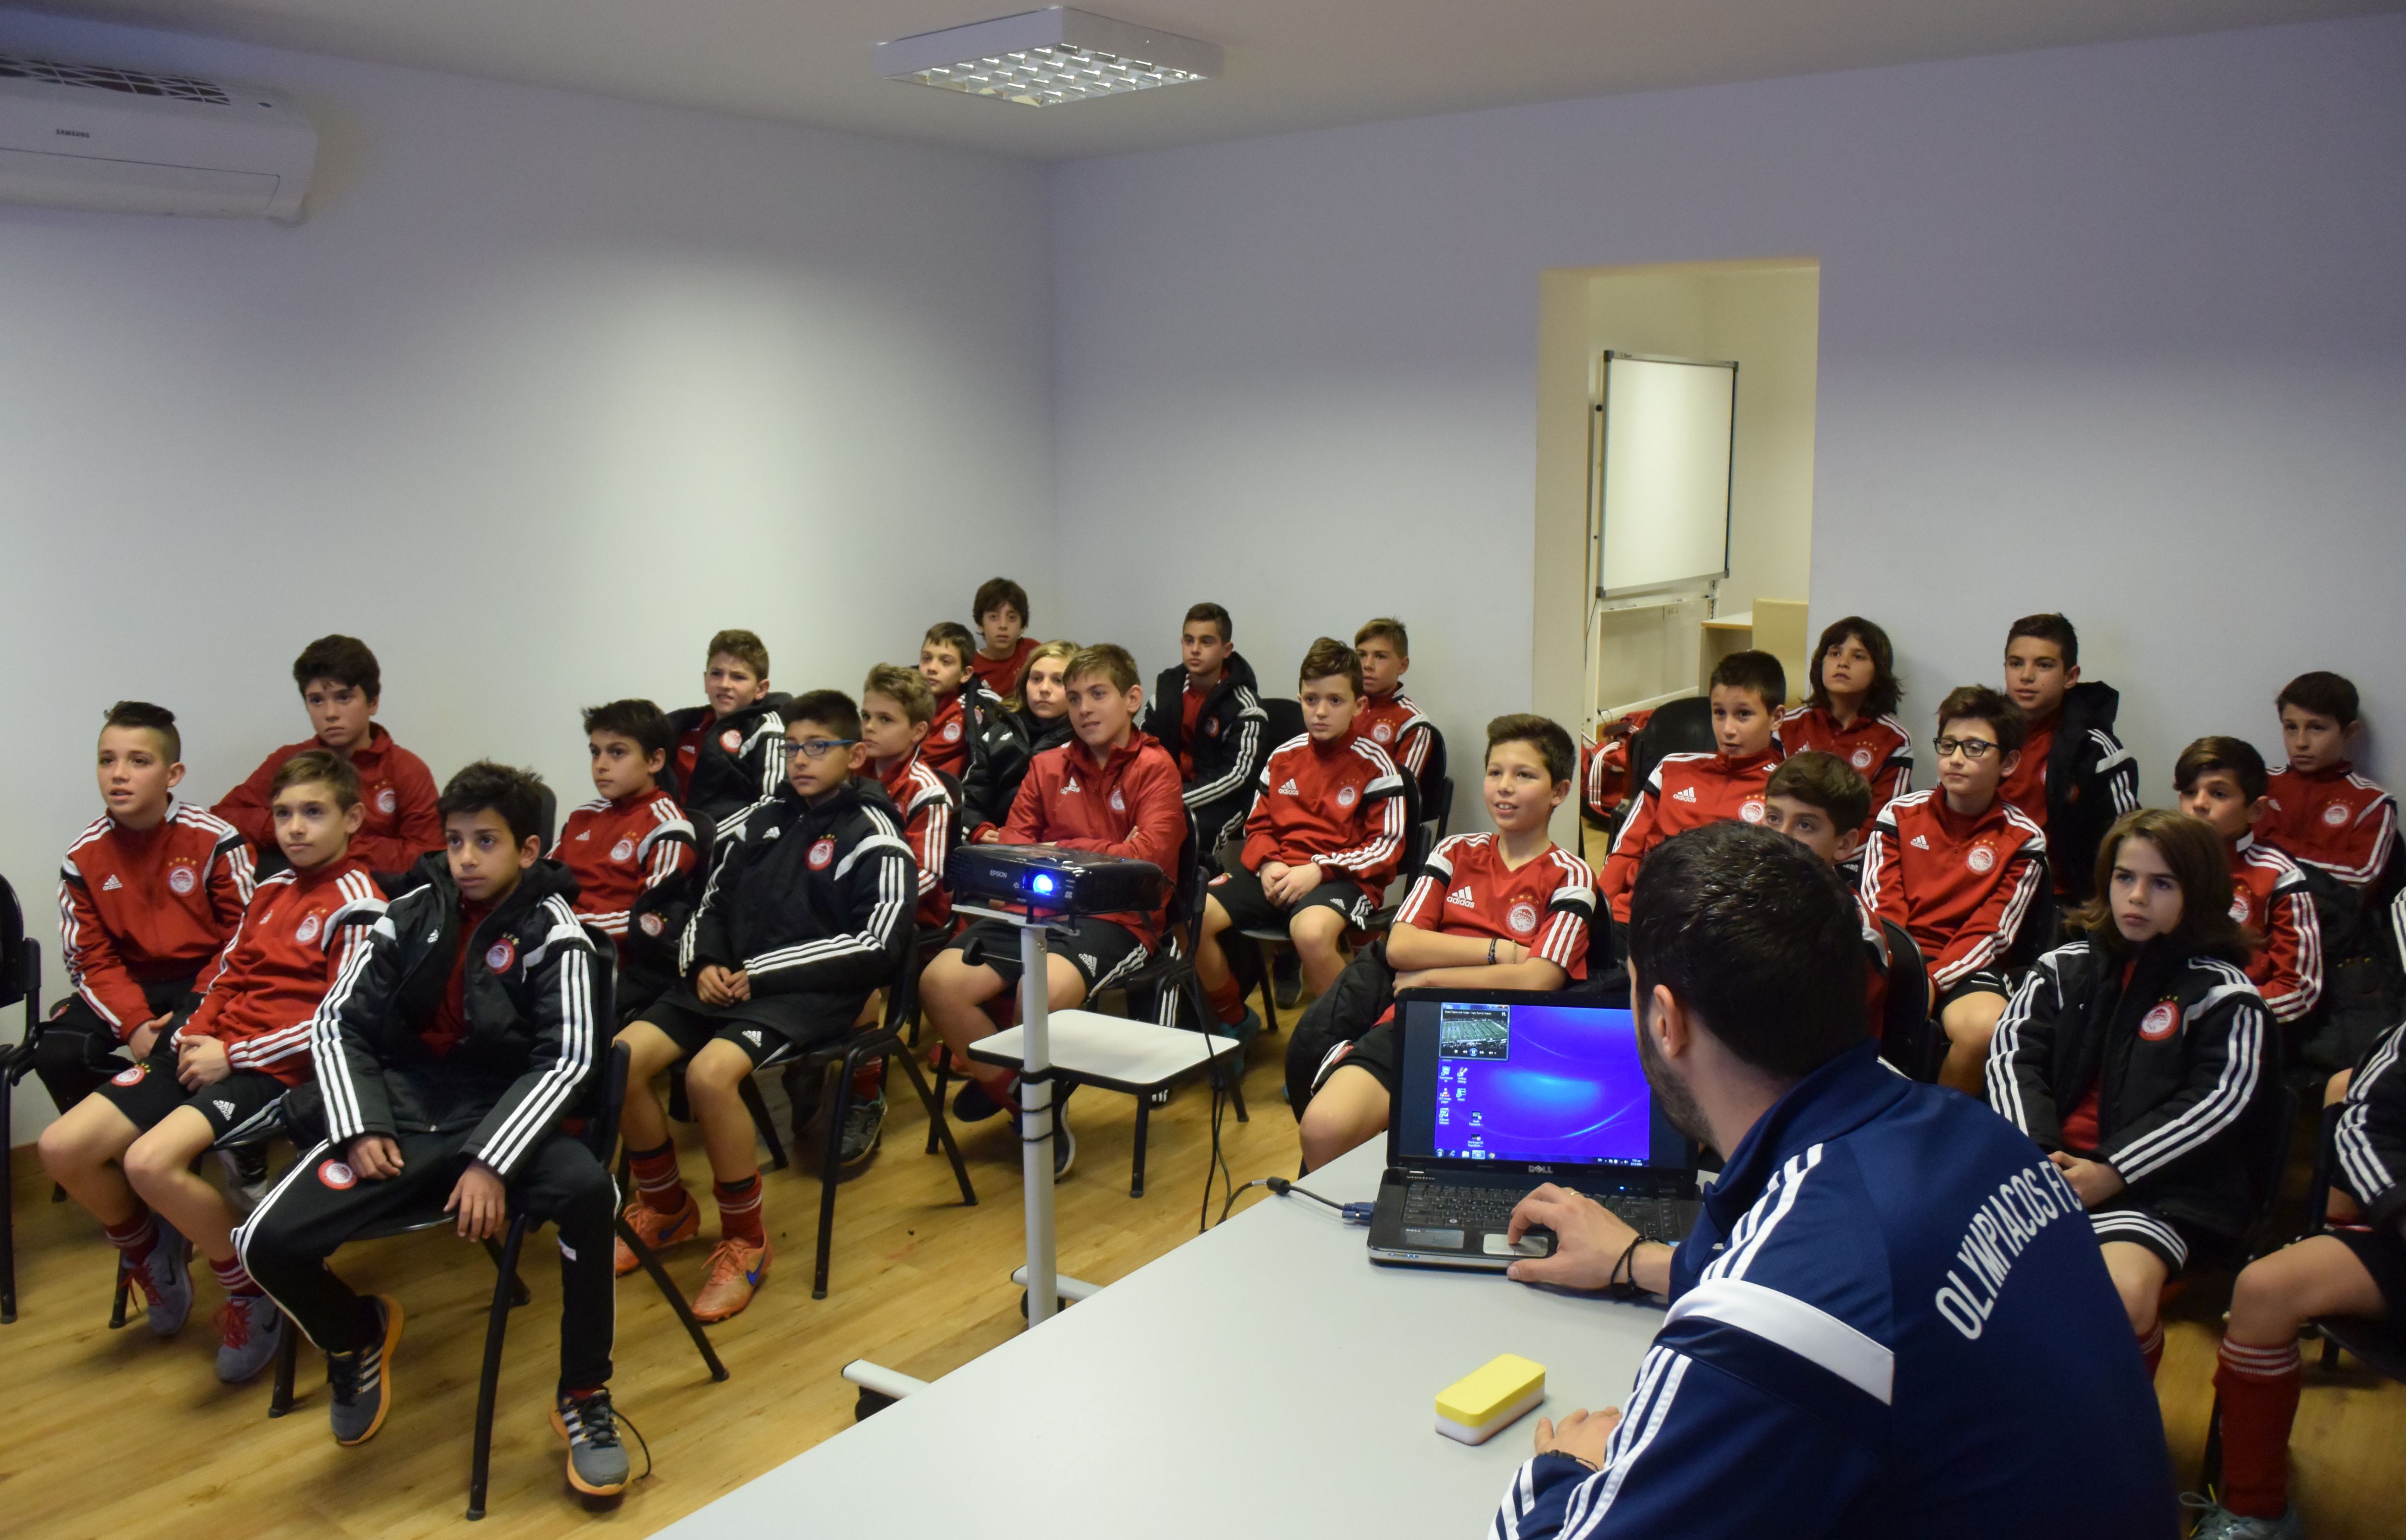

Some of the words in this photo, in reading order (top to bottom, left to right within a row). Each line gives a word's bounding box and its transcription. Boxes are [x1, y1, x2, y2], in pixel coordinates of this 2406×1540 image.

[1278, 786, 1299, 796] adidas
[990, 870, 1008, 878] EPSON
[1446, 896, 1475, 909] adidas
[1528, 1165, 1553, 1173] DELL
[1935, 1167, 2059, 1340] OLYMPIACOS
